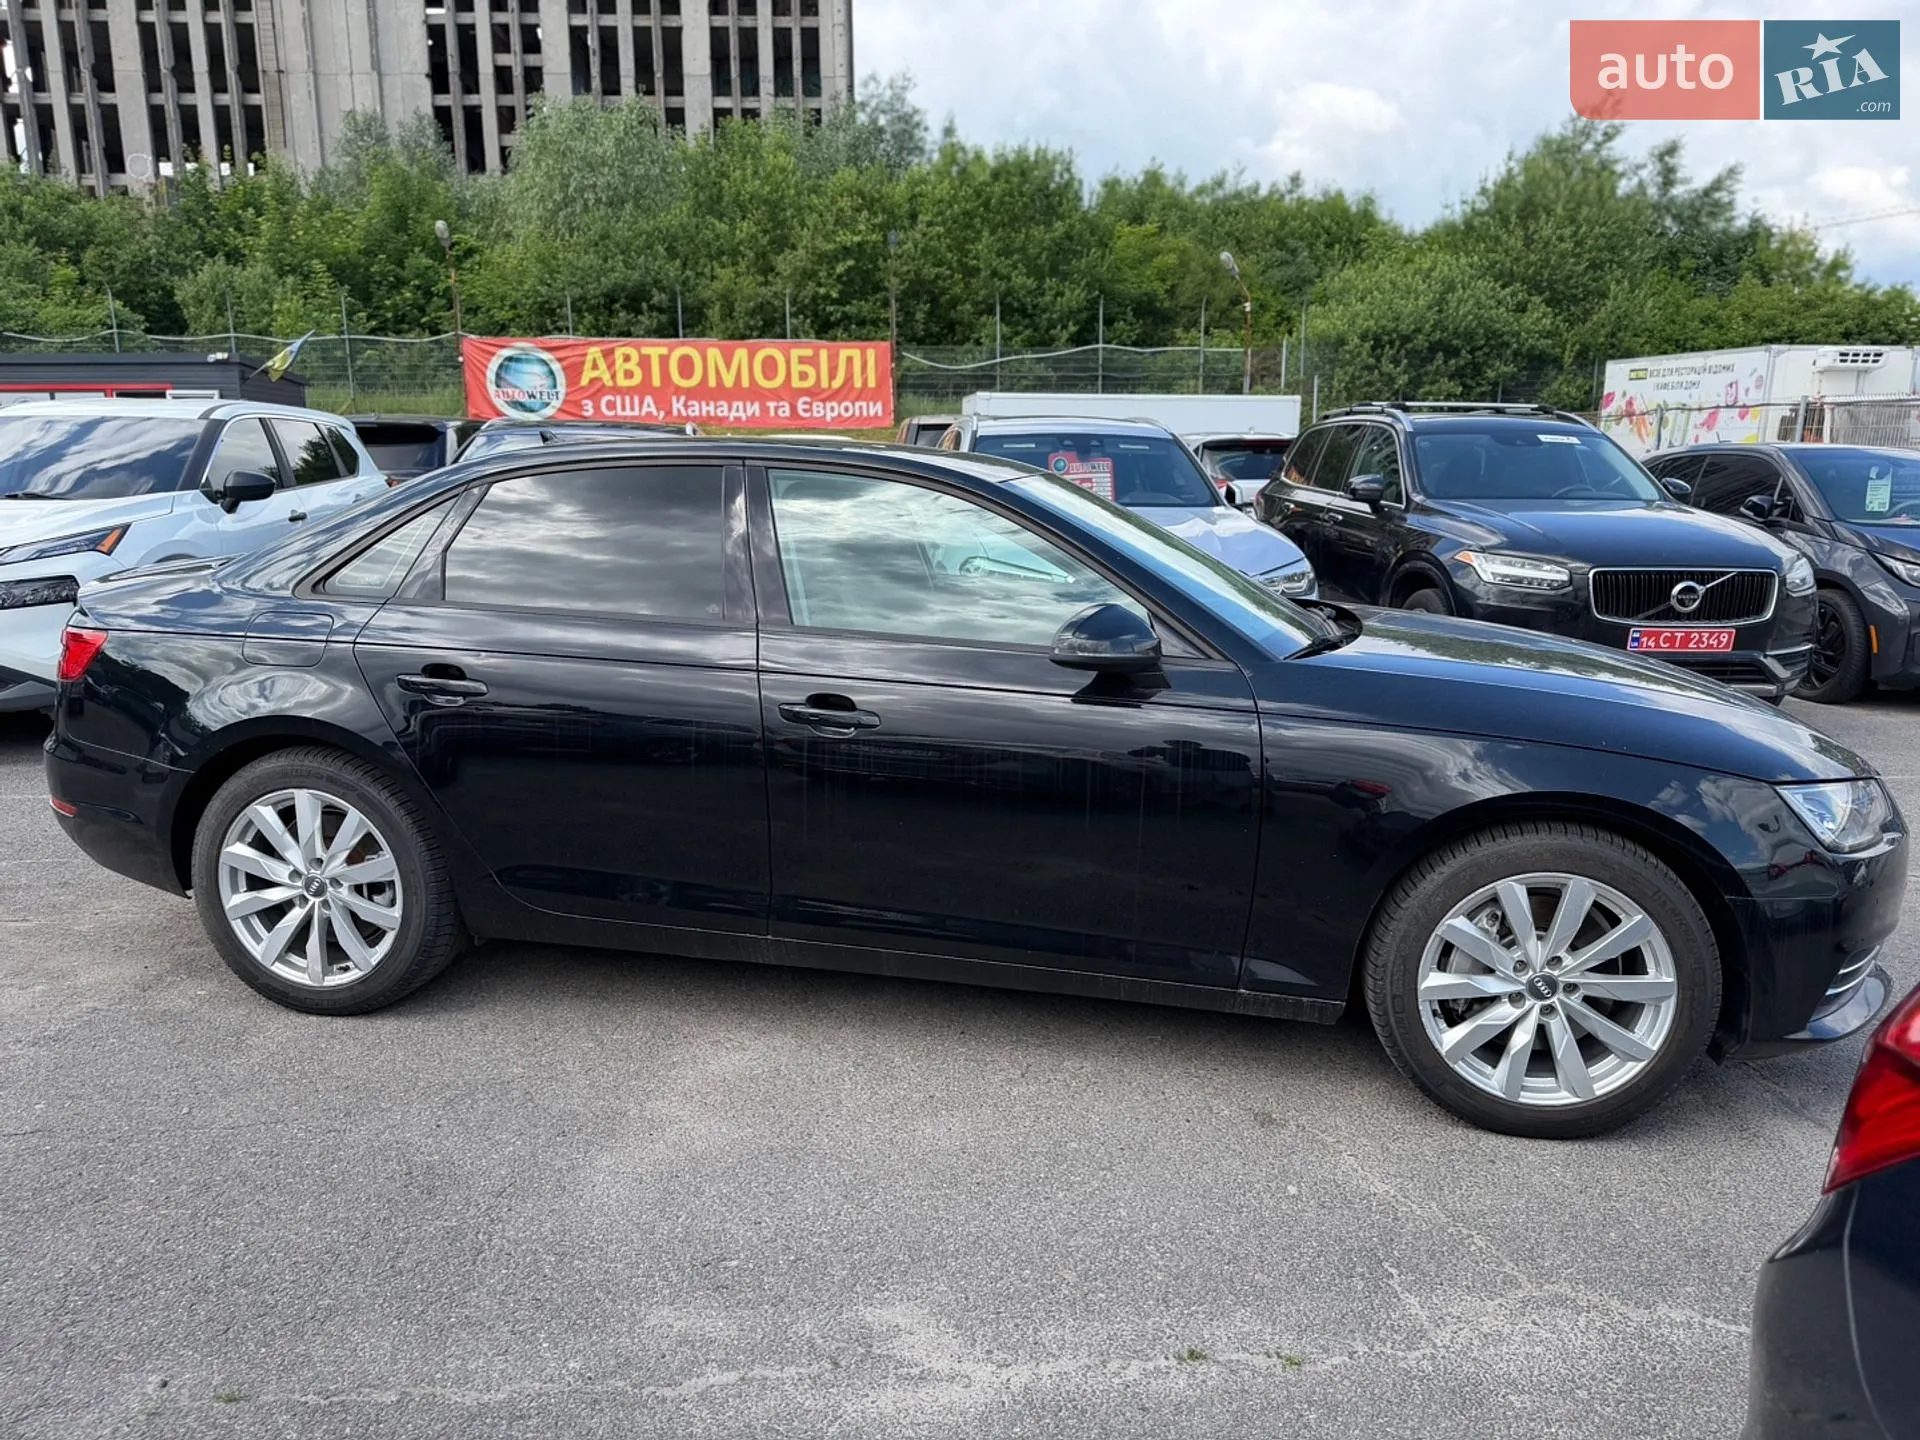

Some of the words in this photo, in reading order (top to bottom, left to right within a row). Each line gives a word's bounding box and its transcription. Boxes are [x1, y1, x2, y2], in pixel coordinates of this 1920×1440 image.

[580, 346, 877, 389] АВТОМОБІЛІ
[581, 399, 595, 416] з
[600, 395, 665, 420] США,
[671, 395, 760, 422] Канади
[766, 400, 791, 417] та
[797, 396, 883, 422] Європи
[1641, 636, 1656, 648] 14
[1660, 632, 1685, 648] CT
[1688, 632, 1729, 648] 2349
